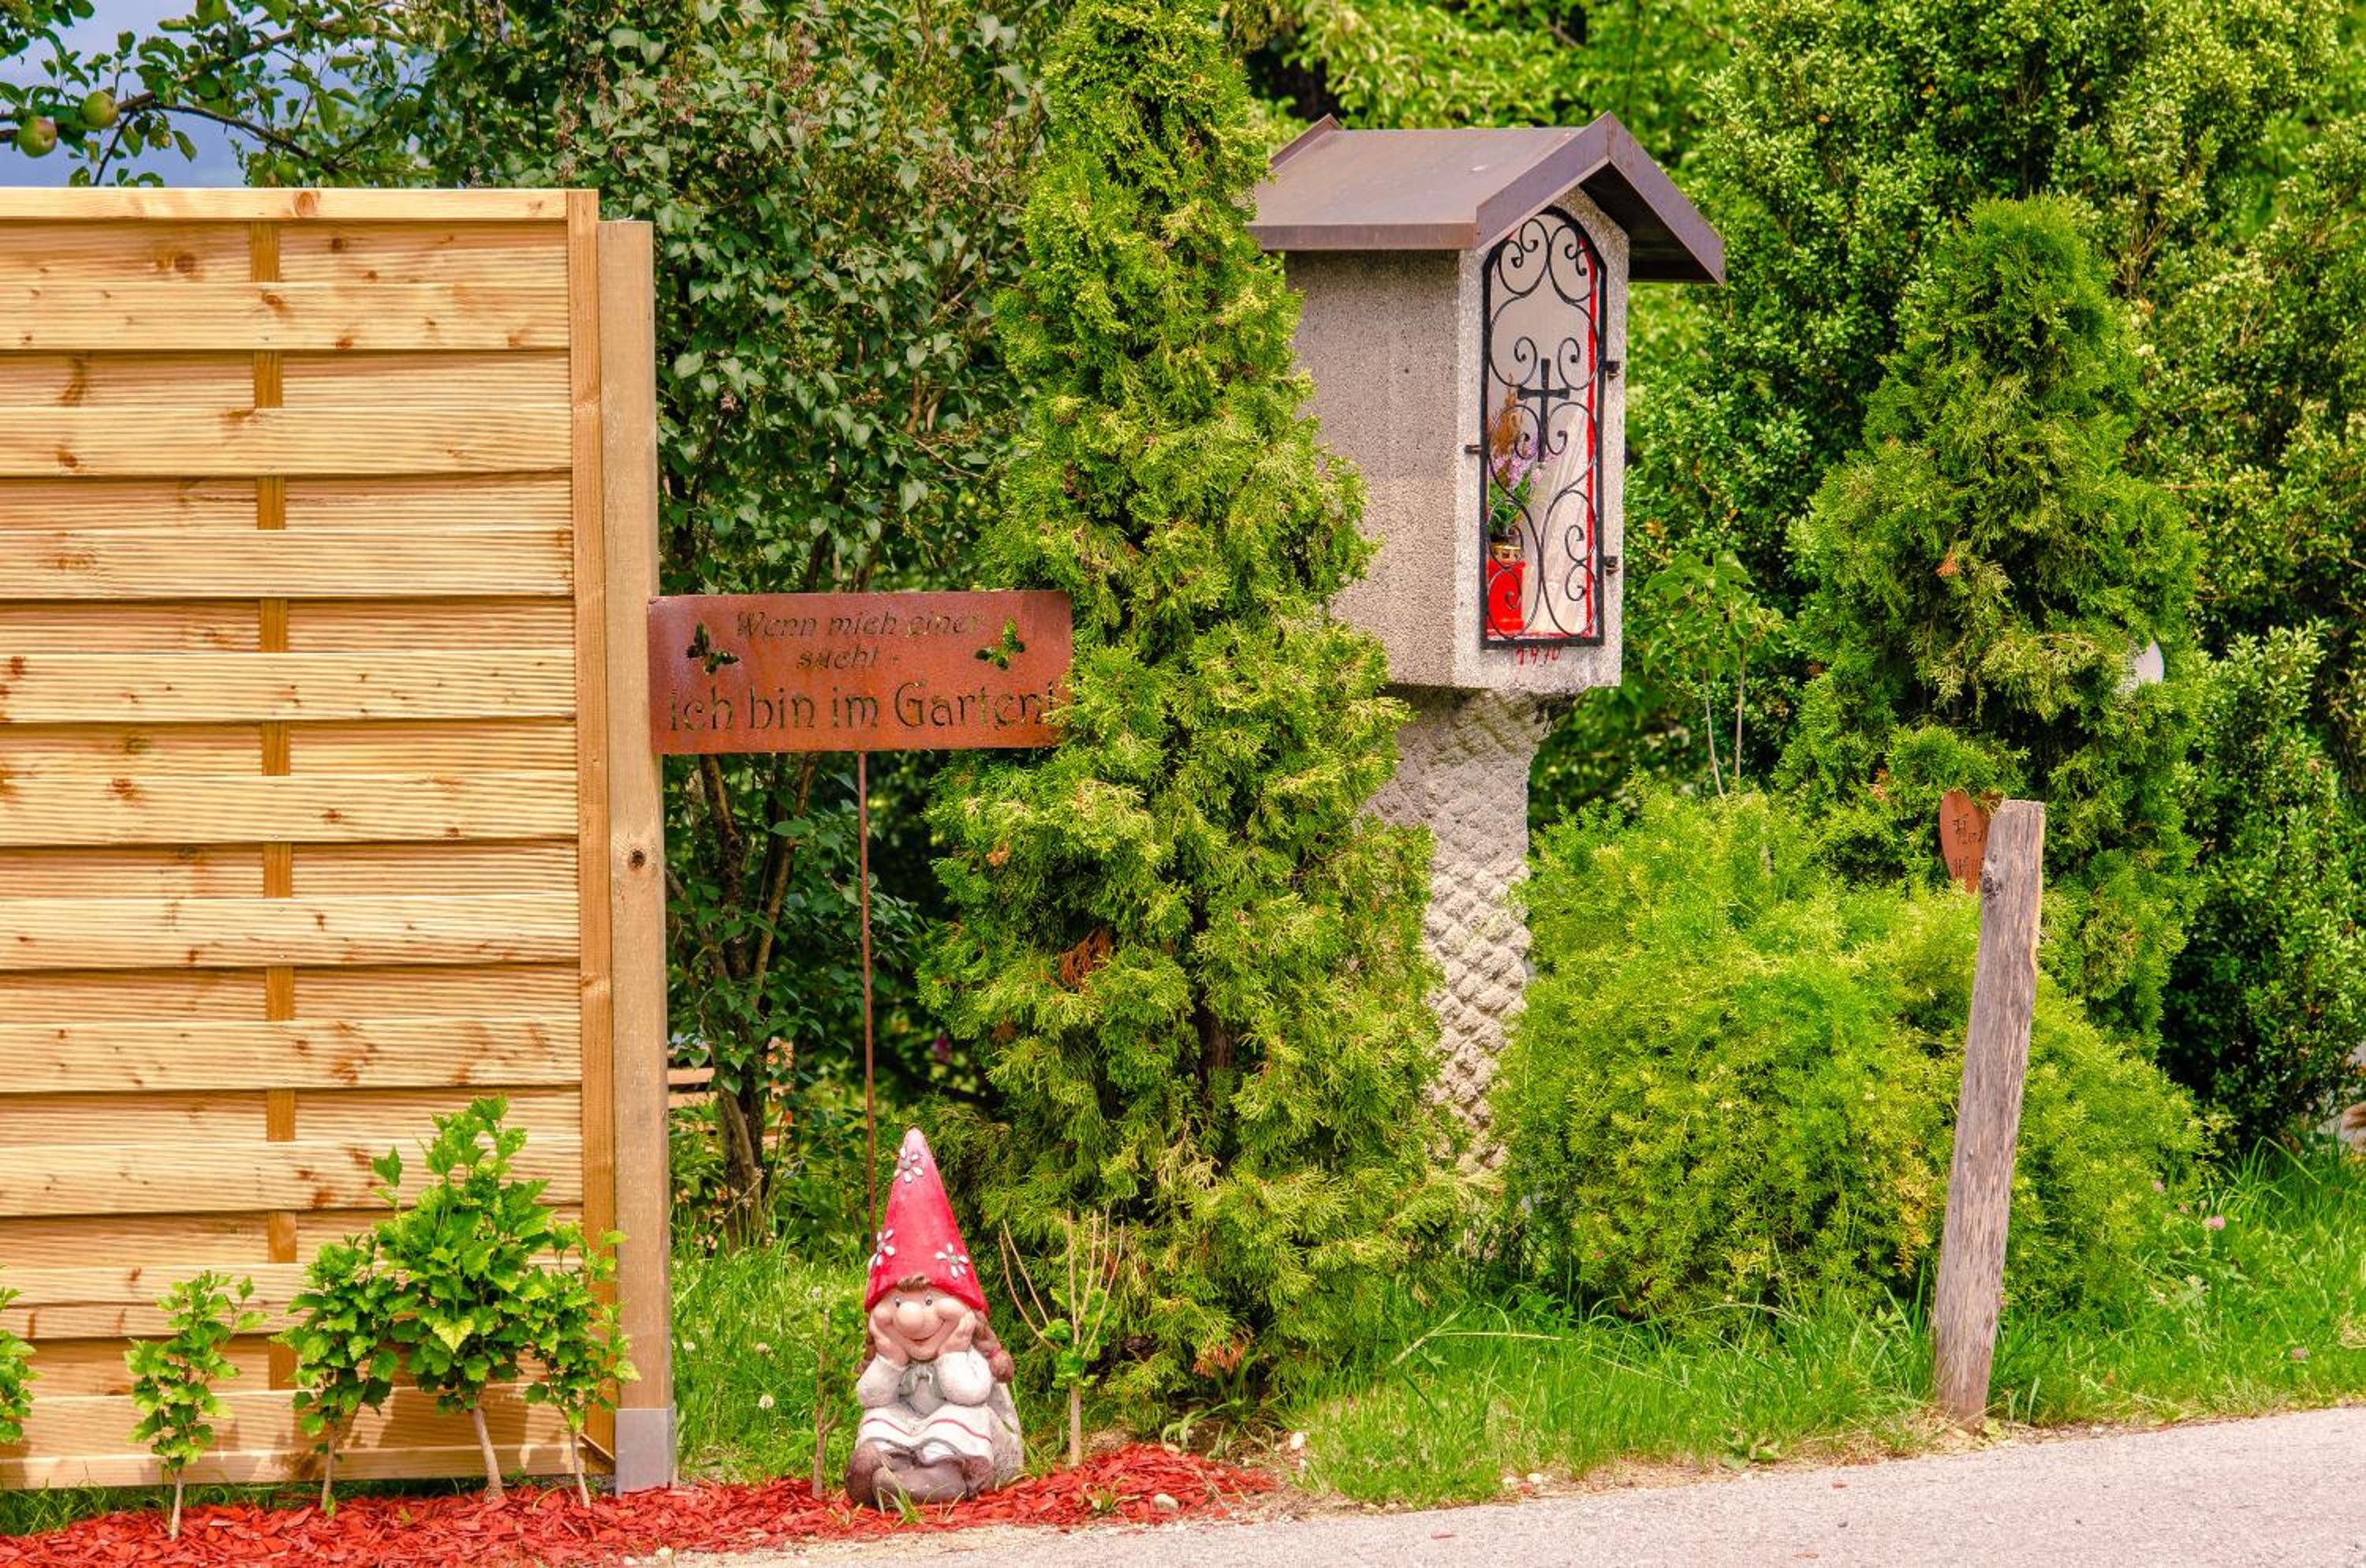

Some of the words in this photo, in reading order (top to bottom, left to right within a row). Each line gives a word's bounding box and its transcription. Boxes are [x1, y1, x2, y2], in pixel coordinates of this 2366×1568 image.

[736, 611, 819, 637] Wenn
[827, 611, 898, 636] mich
[907, 610, 983, 637] einer
[797, 643, 879, 670] sucht
[748, 682, 815, 730] bin
[832, 686, 879, 730] im
